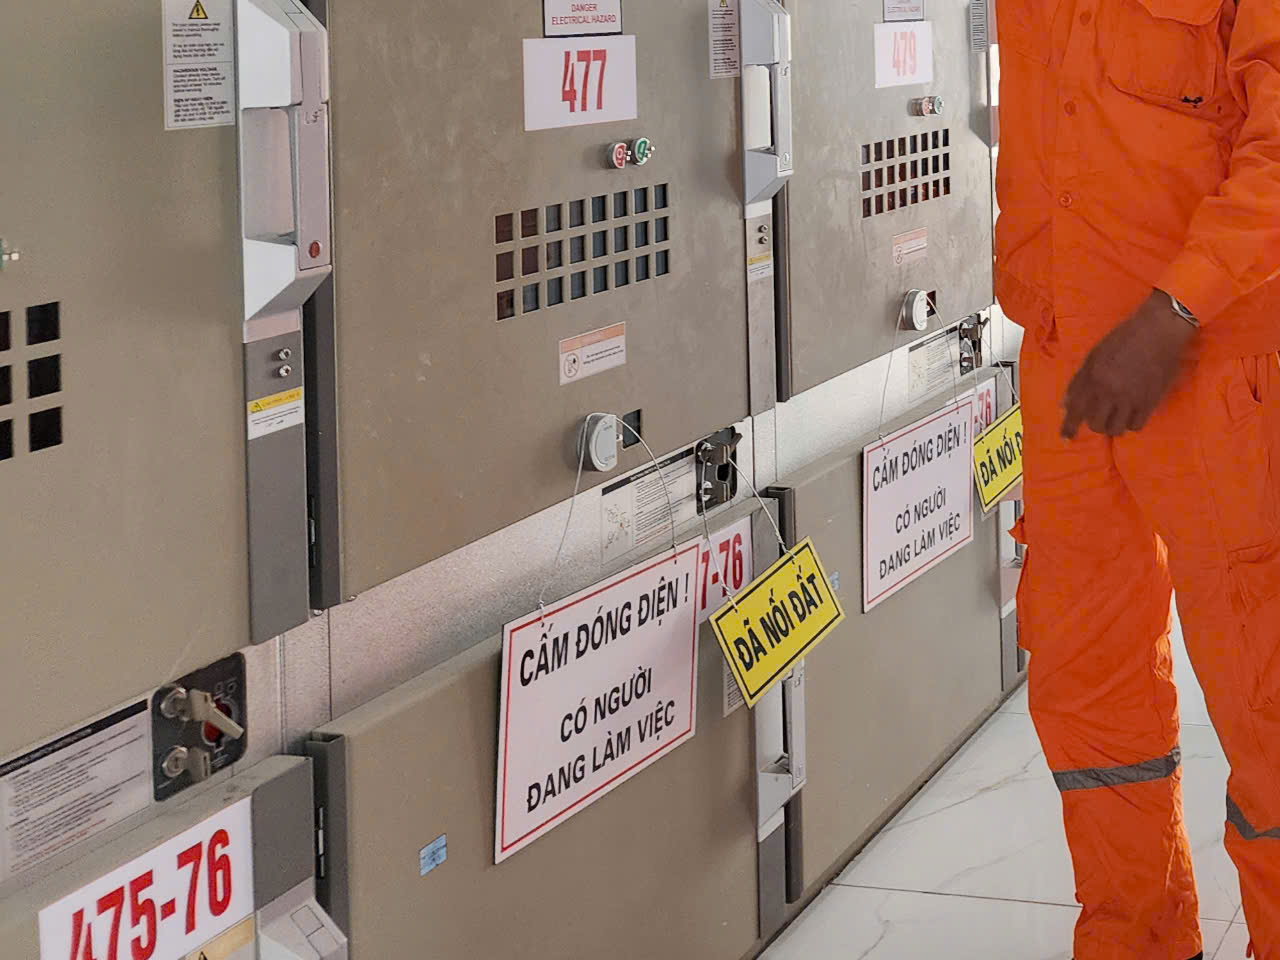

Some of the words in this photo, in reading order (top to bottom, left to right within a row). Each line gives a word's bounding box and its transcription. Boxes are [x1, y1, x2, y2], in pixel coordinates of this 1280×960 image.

[551, 15, 590, 26] ELECTRICAL
[591, 14, 617, 23] HAZARD
[571, 3, 598, 13] DANGER
[562, 48, 607, 113] 477
[873, 447, 899, 492] CẤM
[902, 439, 934, 478] ĐÓNG
[936, 421, 960, 460] ĐIỆN
[895, 506, 911, 534] CÓ
[913, 485, 947, 524] NGƯỜI
[879, 543, 911, 580] ĐANG
[914, 526, 936, 557] LÀM
[938, 512, 961, 542] VIỆC
[520, 621, 569, 687] CẤM
[575, 600, 632, 660] ĐÓNG
[637, 576, 679, 628] ĐIỆN
[732, 617, 768, 672] ĐÃ
[759, 587, 796, 650] NỐI
[787, 565, 825, 624] ĐẤT
[560, 696, 587, 743] CÓ
[593, 666, 653, 725] NGƯỜI
[526, 754, 585, 814] ĐANG
[591, 727, 632, 774] LÀM
[638, 699, 676, 742] VIỆC
